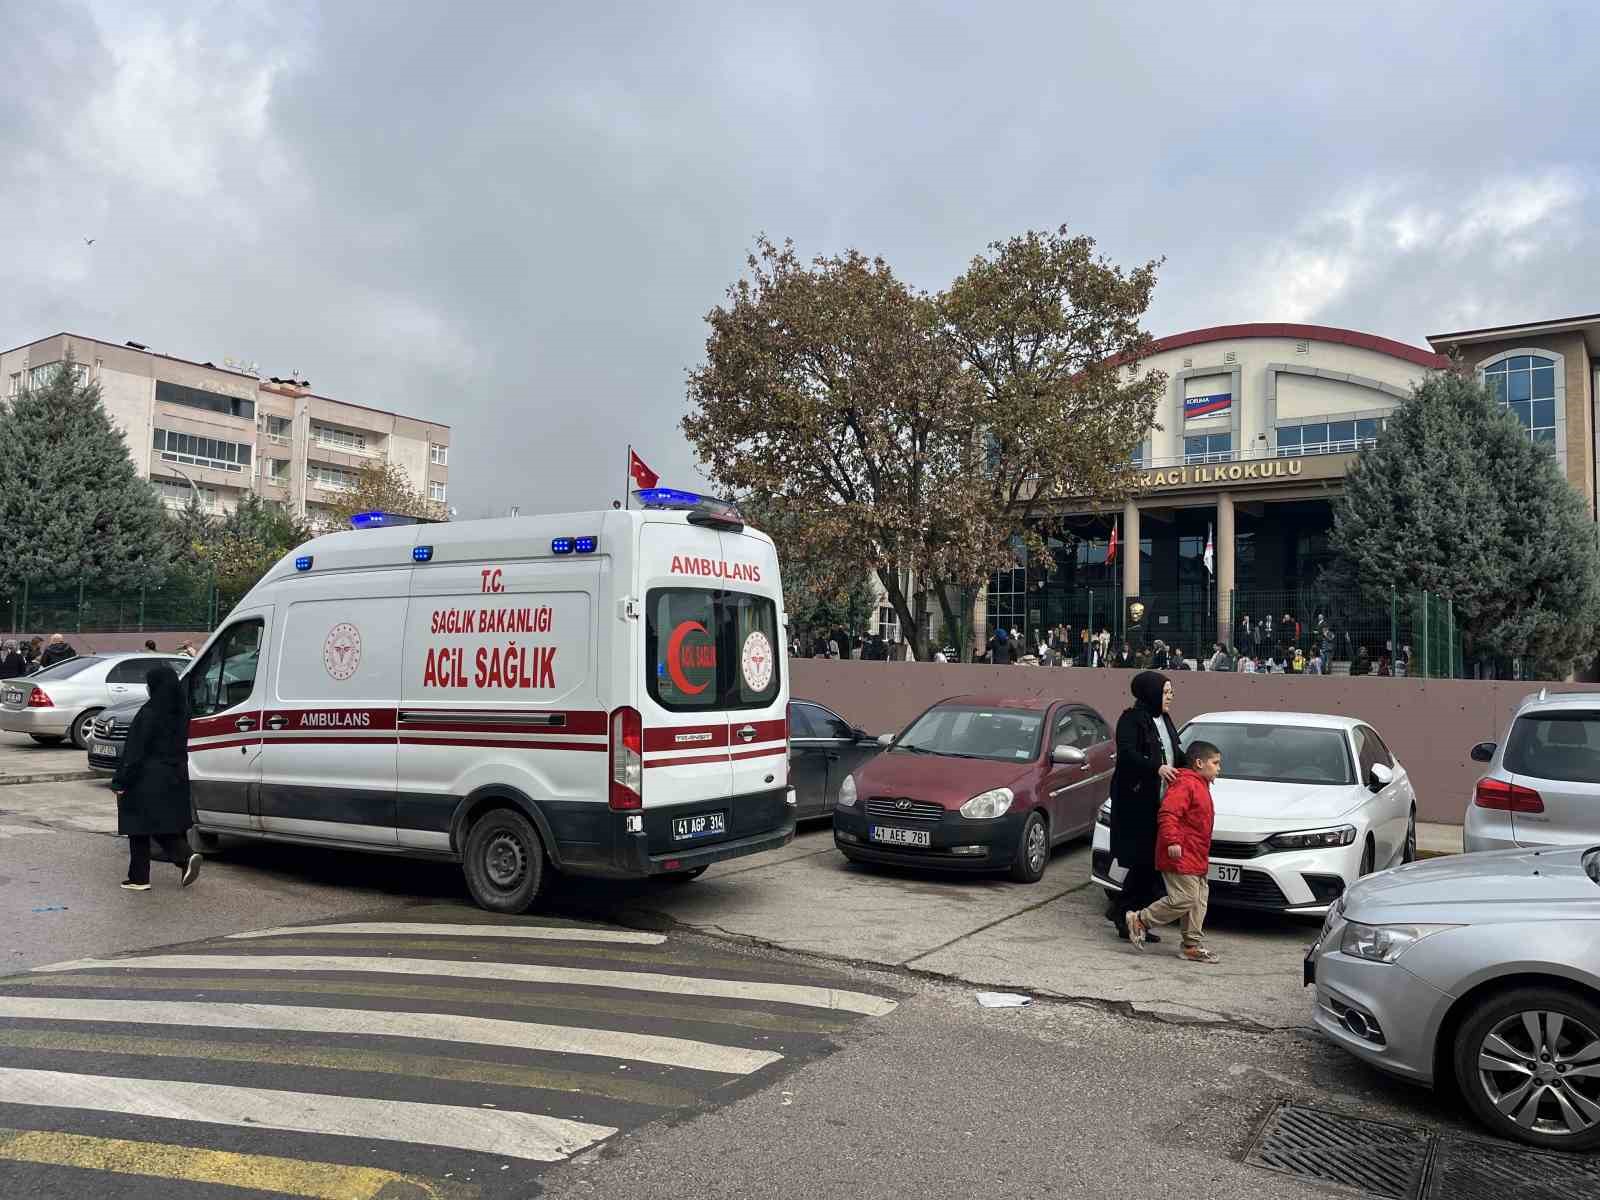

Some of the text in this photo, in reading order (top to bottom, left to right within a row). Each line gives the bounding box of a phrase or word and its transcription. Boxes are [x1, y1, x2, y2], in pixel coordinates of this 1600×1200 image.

[1194, 460, 1302, 484] İLKOKULU
[671, 555, 761, 582] AMBULANS
[481, 569, 505, 592] T.C.
[431, 604, 552, 634] SAĞLIK BAKANLIĞI
[474, 640, 556, 689] SAĞLIK
[299, 712, 370, 727] AMBULANS
[678, 815, 723, 834] 41 AGP 314
[875, 829, 928, 844] 41 AEE 781
[1218, 866, 1239, 881] 517
